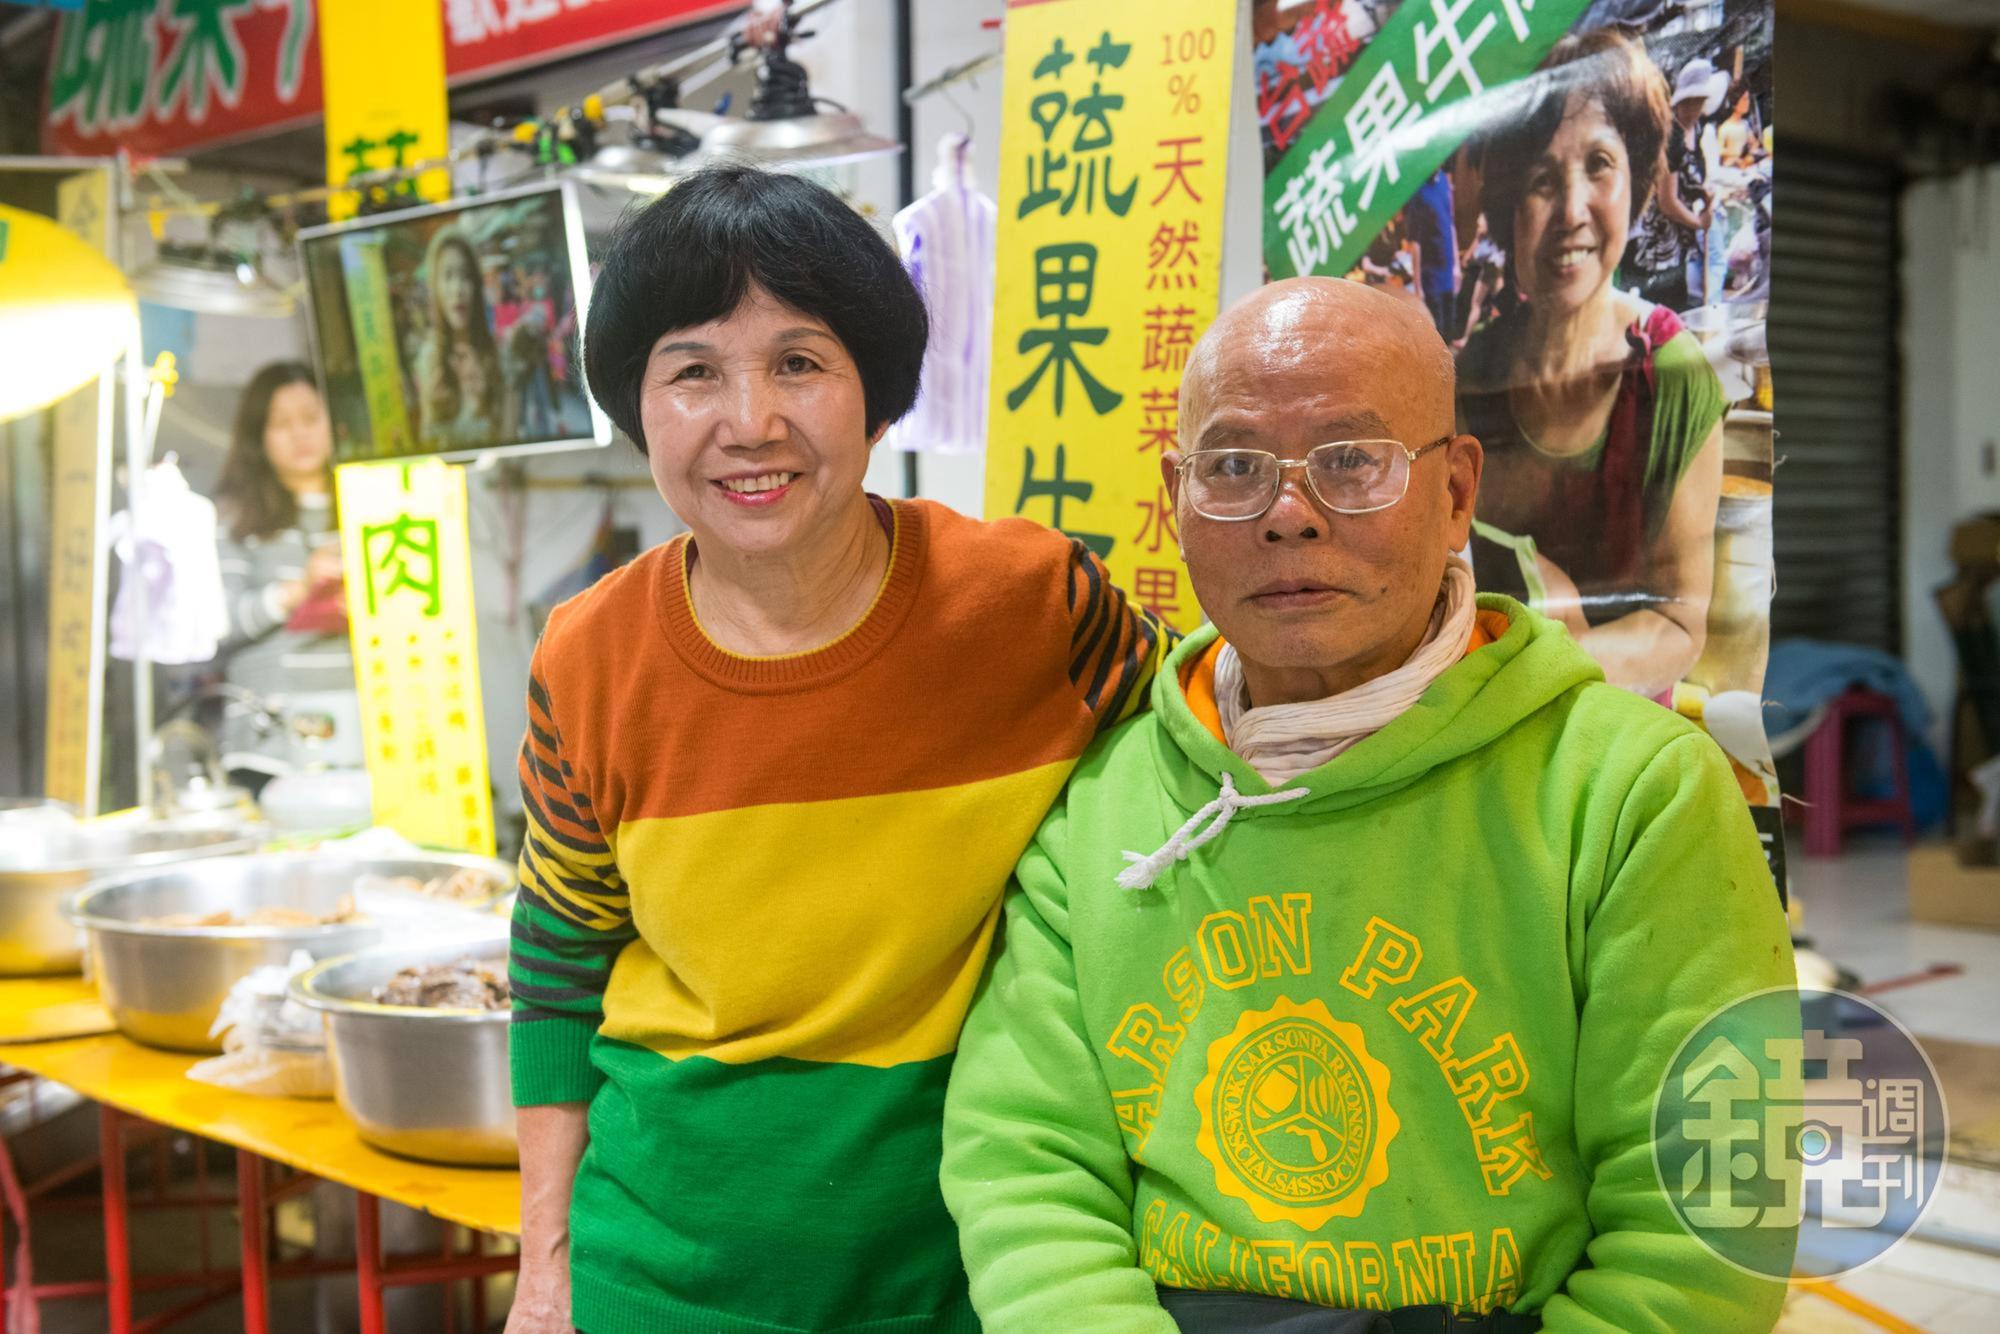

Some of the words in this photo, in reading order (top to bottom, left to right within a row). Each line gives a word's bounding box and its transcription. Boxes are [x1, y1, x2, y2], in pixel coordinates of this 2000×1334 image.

[1273, 0, 1536, 277] 蔬果牛
[1339, 915, 1553, 1196] PARK
[1140, 1199, 1522, 1315] CALIFORNIA
